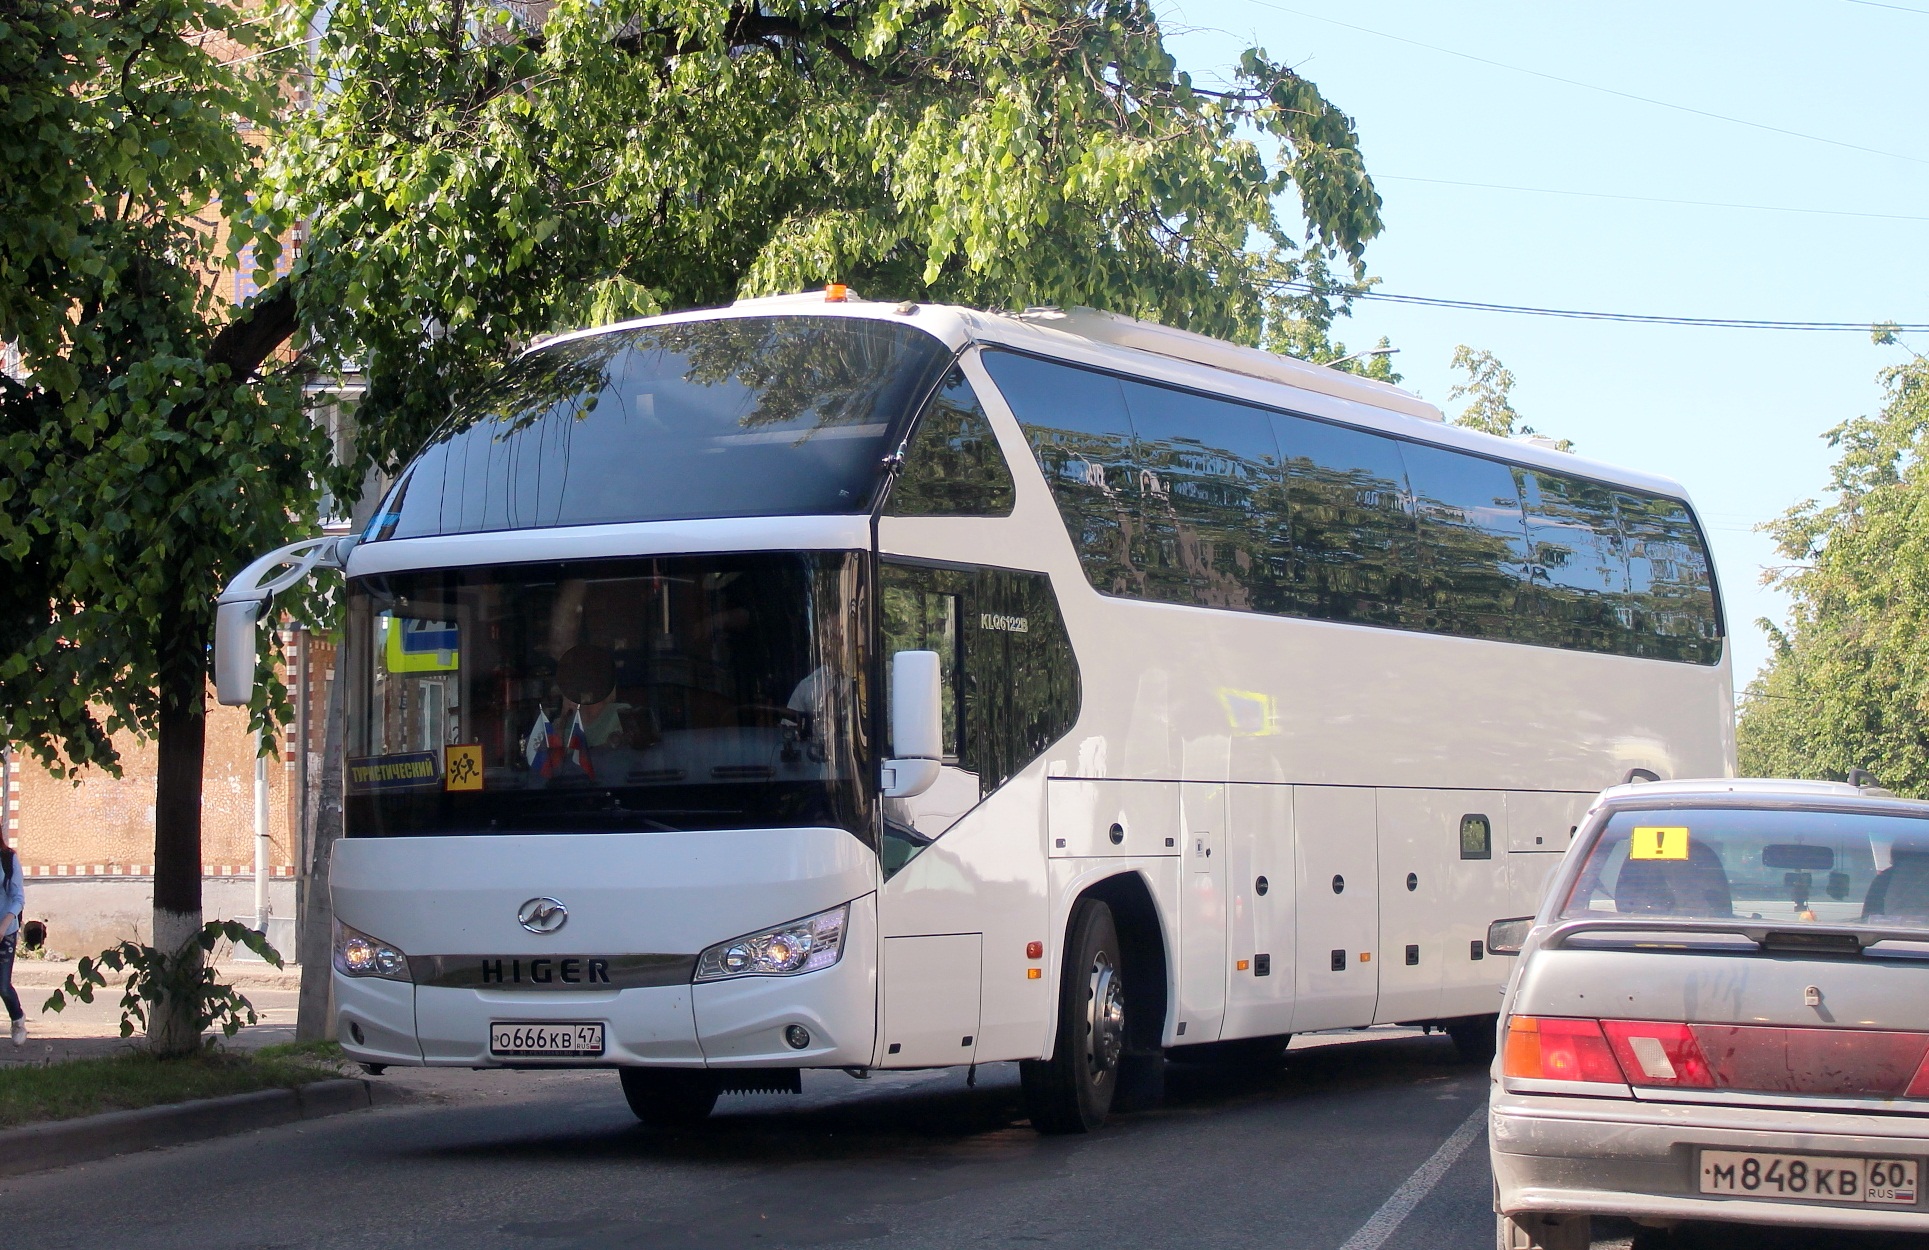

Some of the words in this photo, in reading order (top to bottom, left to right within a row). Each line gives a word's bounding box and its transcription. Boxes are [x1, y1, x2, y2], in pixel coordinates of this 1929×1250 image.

[981, 613, 1028, 633] KLQ6122B
[351, 758, 434, 783] ТУРИСТИЧЕСКИЙ
[482, 959, 611, 984] HIGER
[500, 1028, 572, 1048] О666КВ
[578, 1027, 596, 1043] 47
[1713, 1157, 1858, 1196] М848КВ
[1870, 1162, 1905, 1188] 60
[1868, 1188, 1894, 1199] RUS
